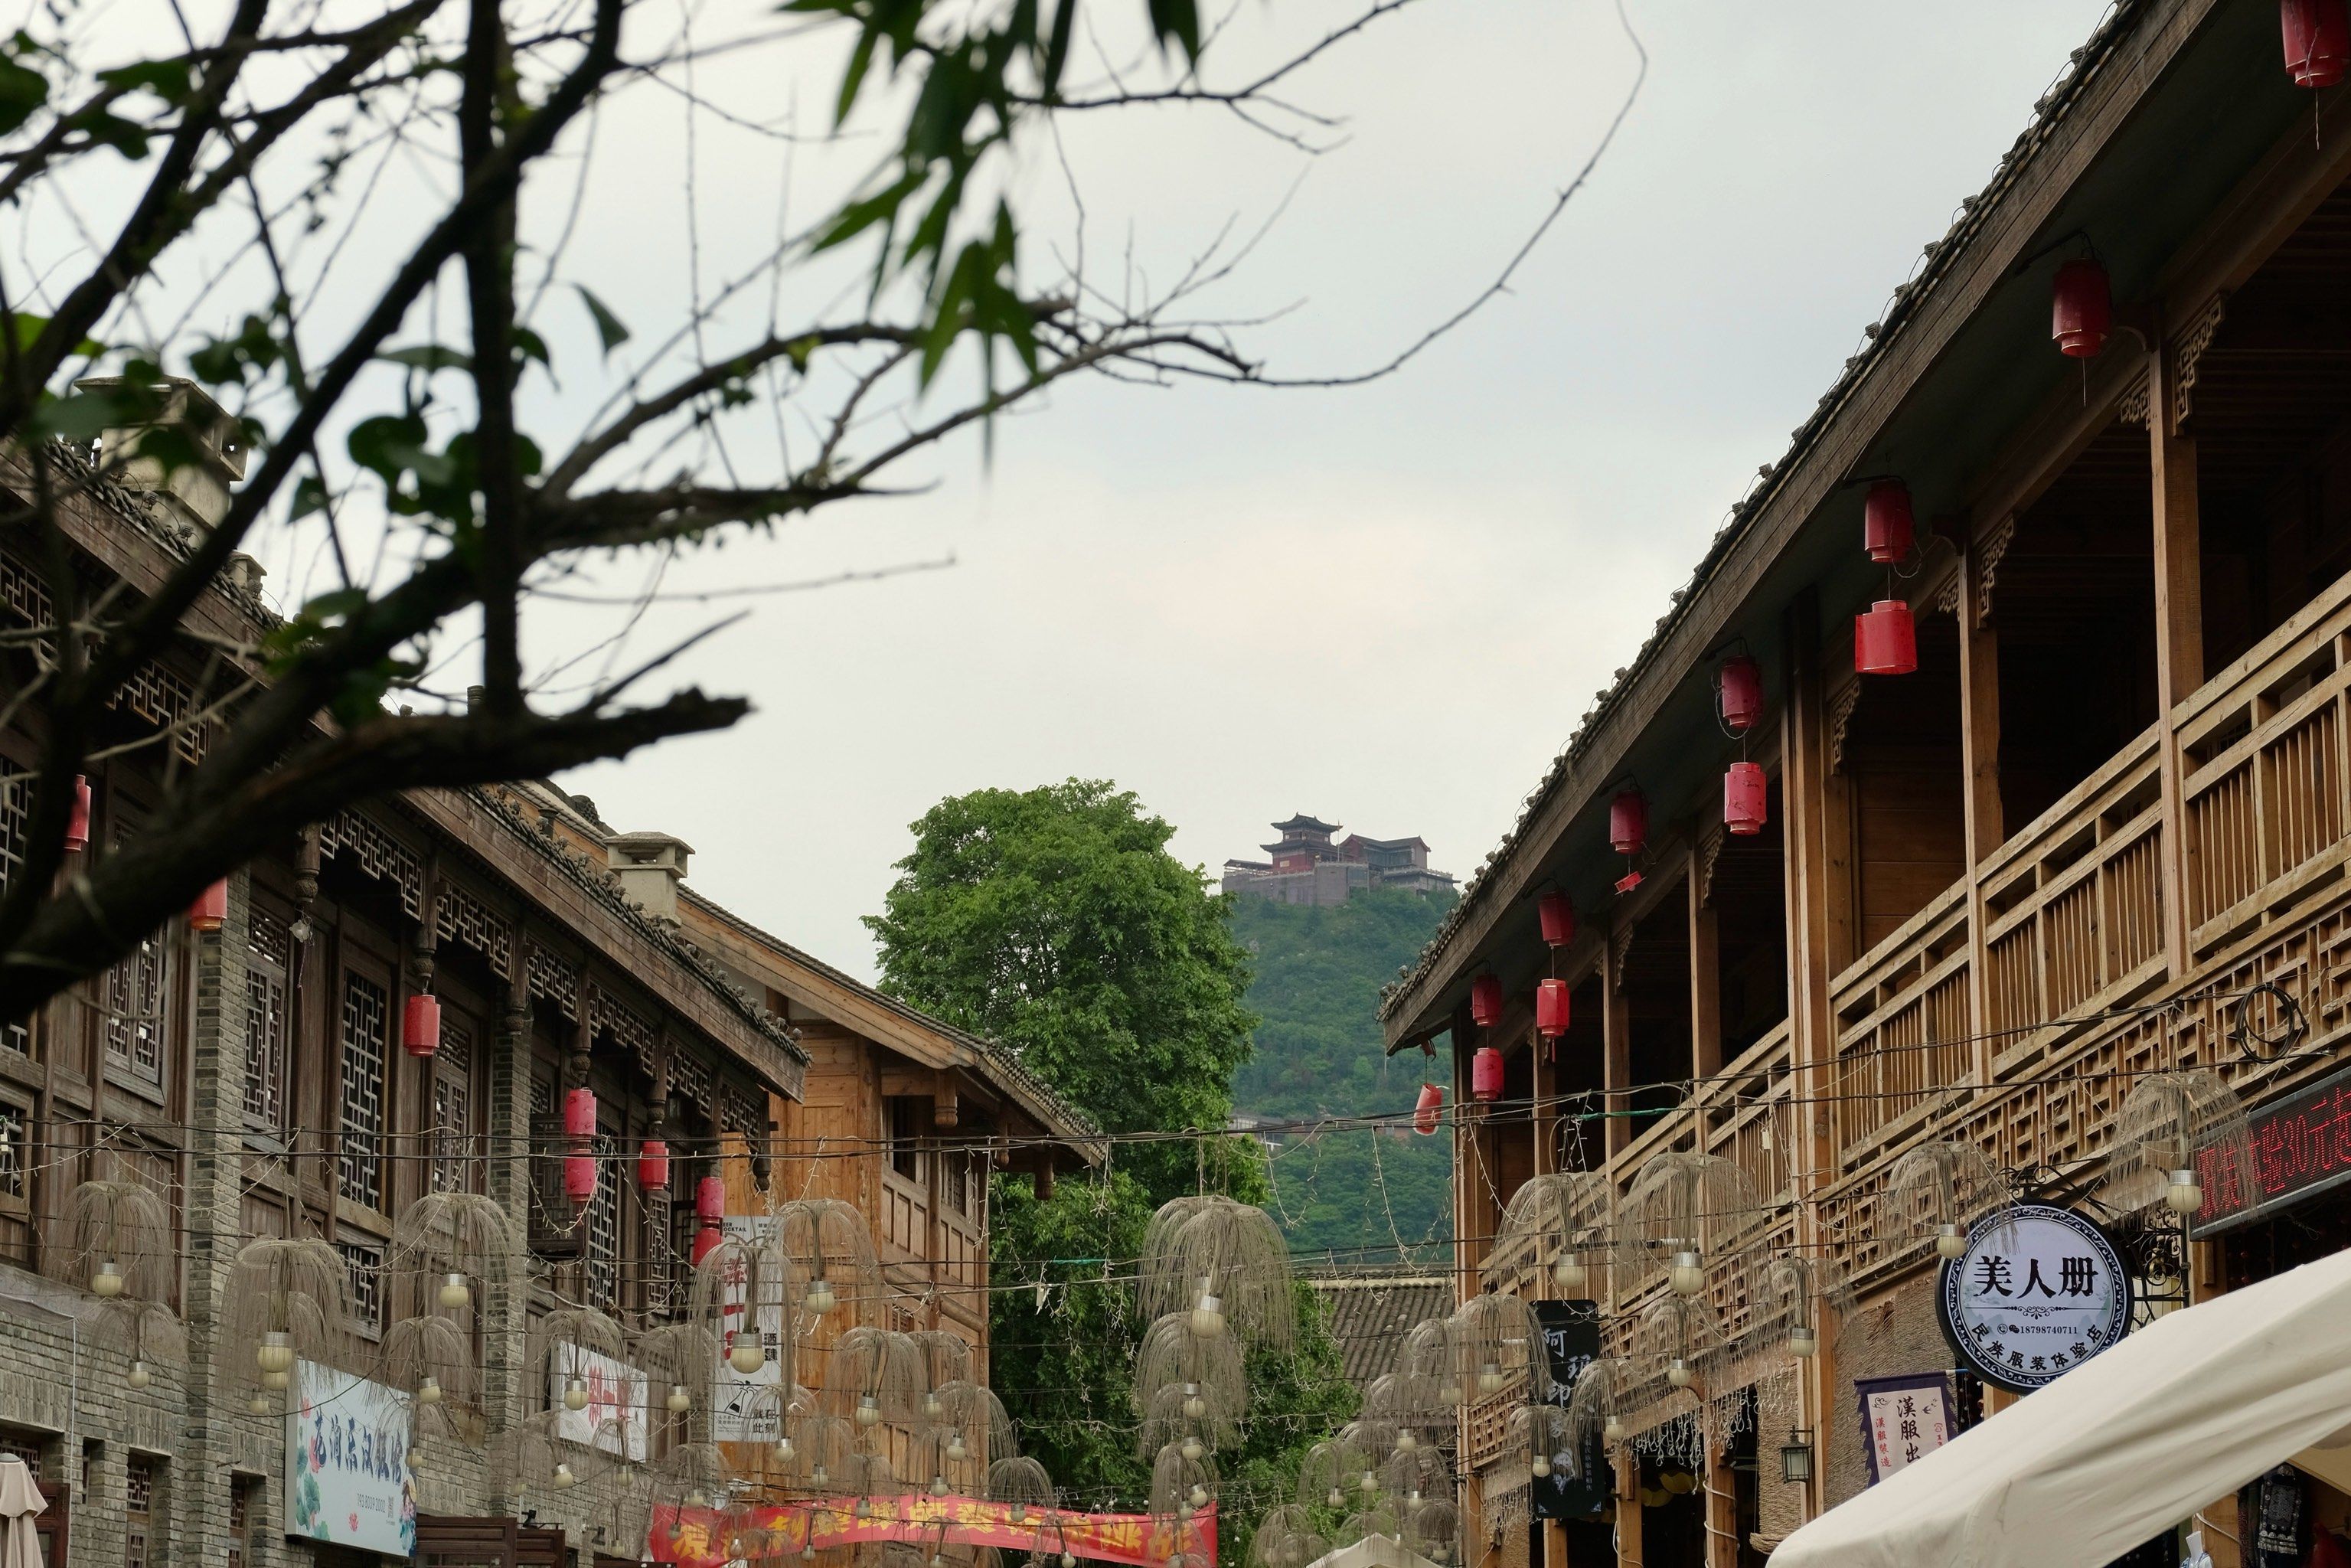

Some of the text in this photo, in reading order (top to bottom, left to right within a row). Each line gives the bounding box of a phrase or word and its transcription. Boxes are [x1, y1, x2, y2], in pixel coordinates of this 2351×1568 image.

[1973, 1255, 2098, 1299] 美人册
[1971, 1322, 2104, 1371] 民族服装体验店
[2020, 1325, 2078, 1334] 18798740711
[1896, 1395, 1922, 1464] 漢服出
